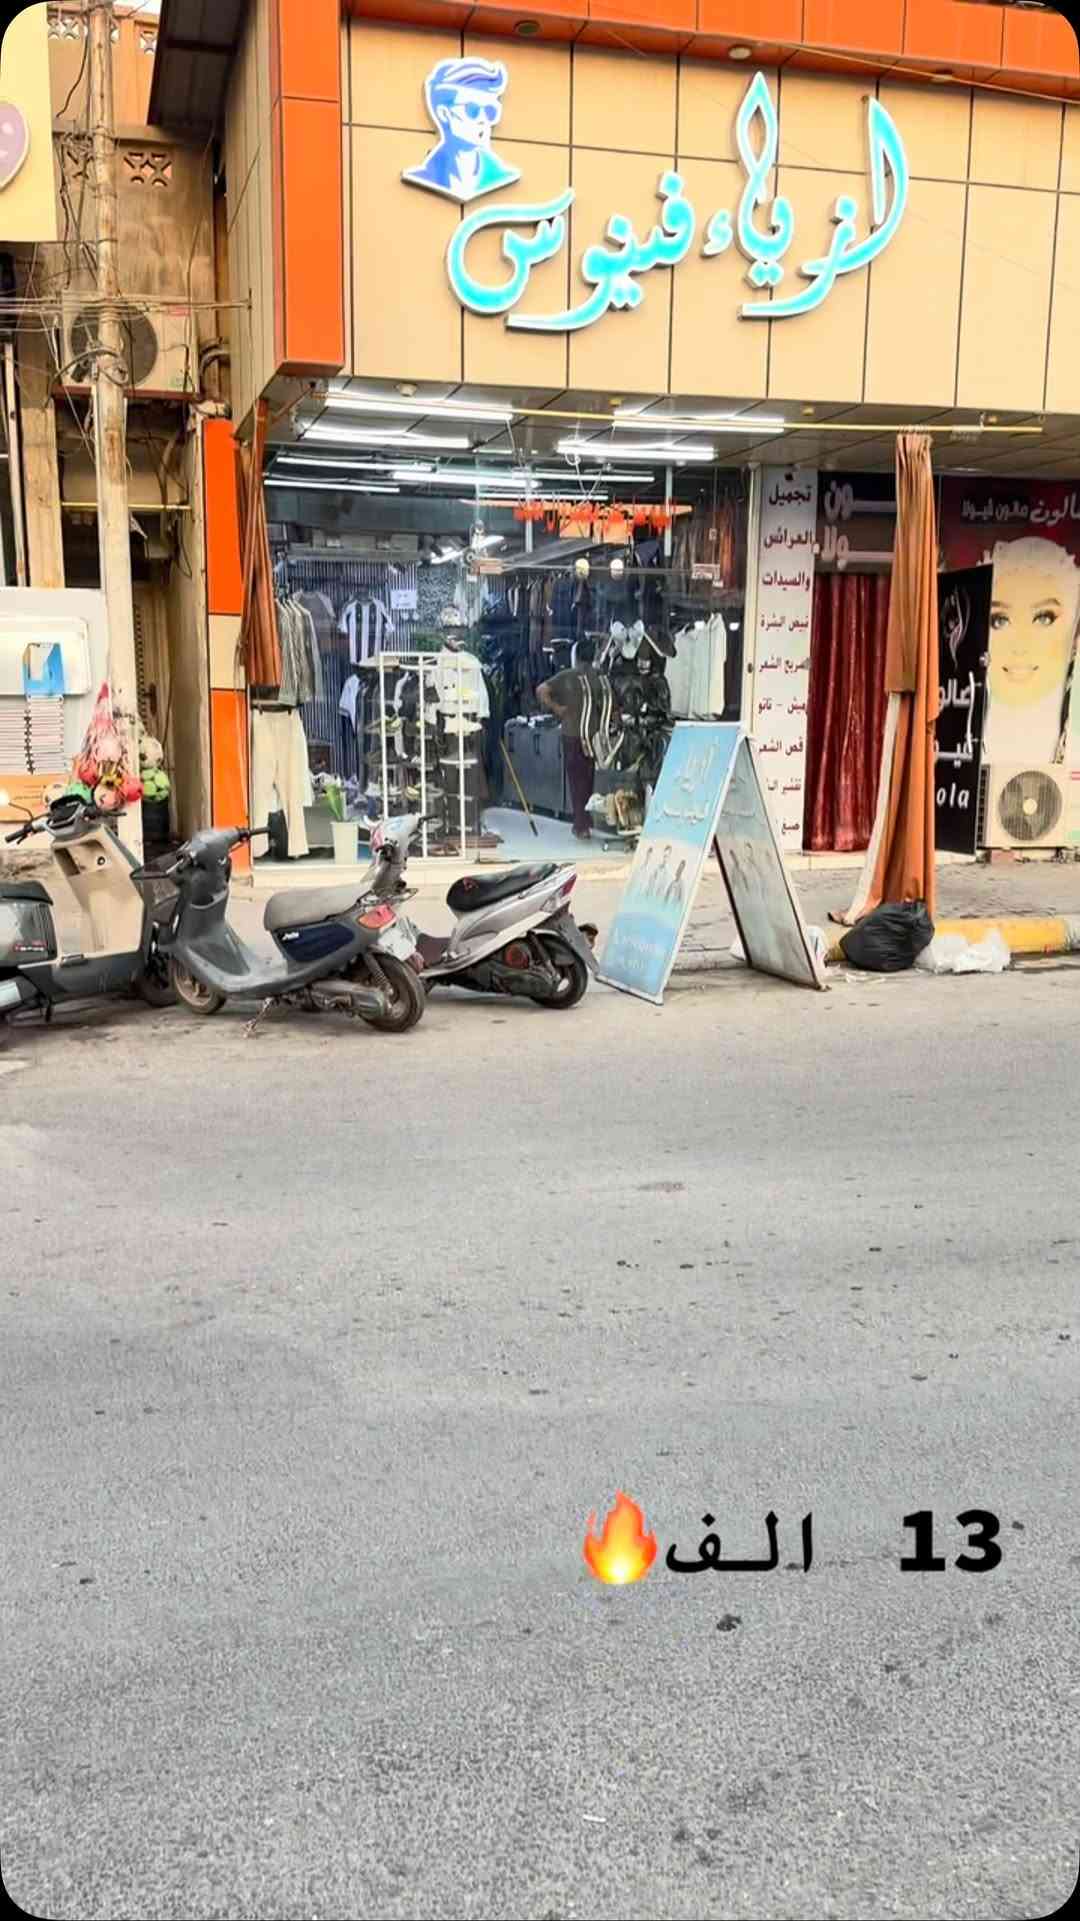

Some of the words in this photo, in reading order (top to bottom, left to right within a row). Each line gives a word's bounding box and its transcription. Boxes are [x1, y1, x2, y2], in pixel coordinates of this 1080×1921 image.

[446, 168, 696, 332] فينوس
[769, 484, 811, 506] تجميل
[761, 570, 811, 592] والسيدات
[935, 782, 971, 810] ola
